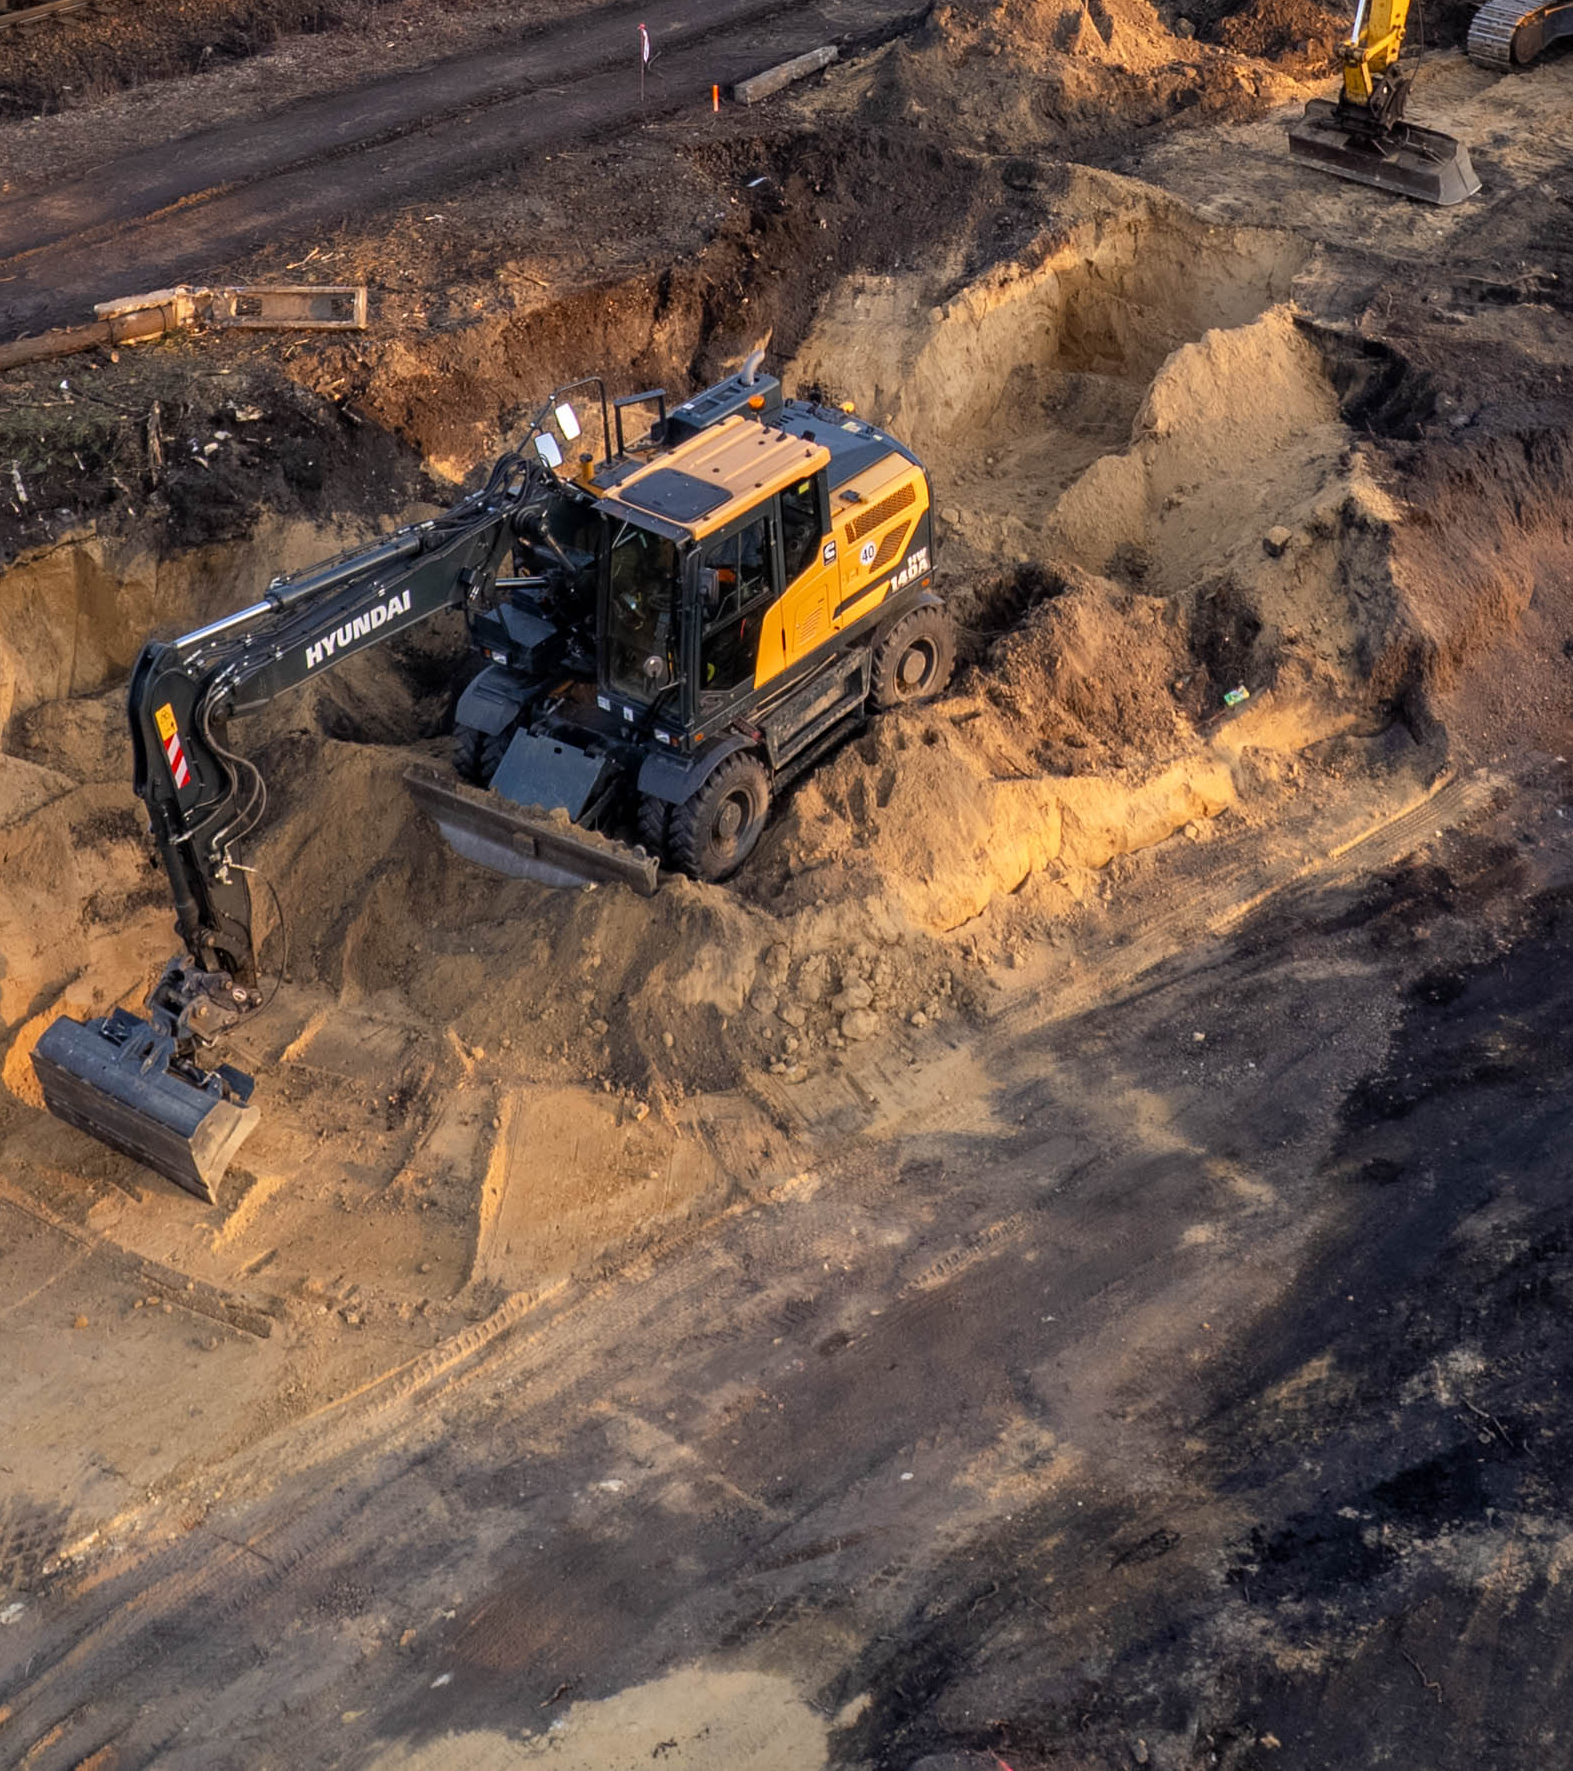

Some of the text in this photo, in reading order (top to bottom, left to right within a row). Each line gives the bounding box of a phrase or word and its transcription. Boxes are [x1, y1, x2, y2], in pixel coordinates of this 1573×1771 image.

[862, 545, 875, 562] 40
[907, 547, 927, 567] HW
[891, 558, 931, 593] 140A
[305, 590, 411, 669] HYUNDAI
